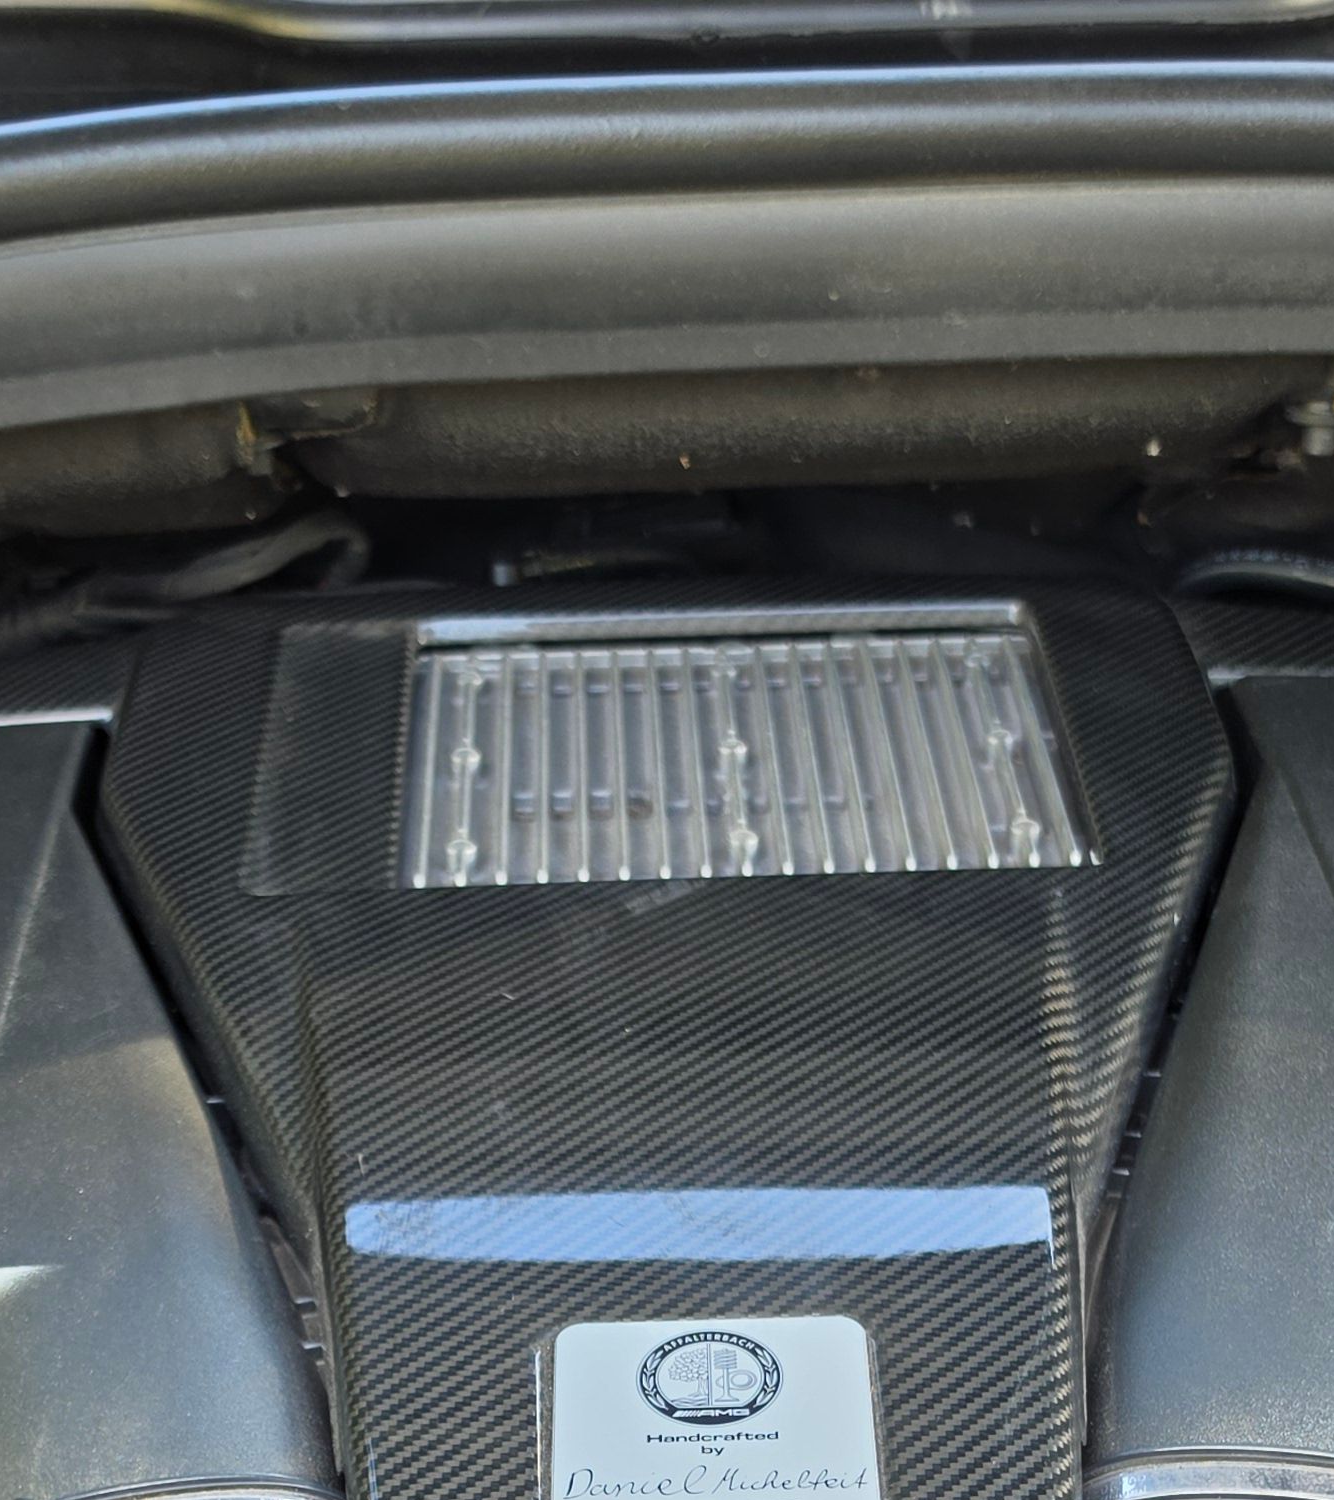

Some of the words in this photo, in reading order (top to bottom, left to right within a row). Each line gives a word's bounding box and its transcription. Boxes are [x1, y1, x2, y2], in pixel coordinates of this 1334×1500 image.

[697, 1408, 750, 1417] AMG
[647, 1431, 779, 1443] Handcrafted
[701, 1445, 725, 1457] by
[563, 1464, 708, 1500] Daniel
